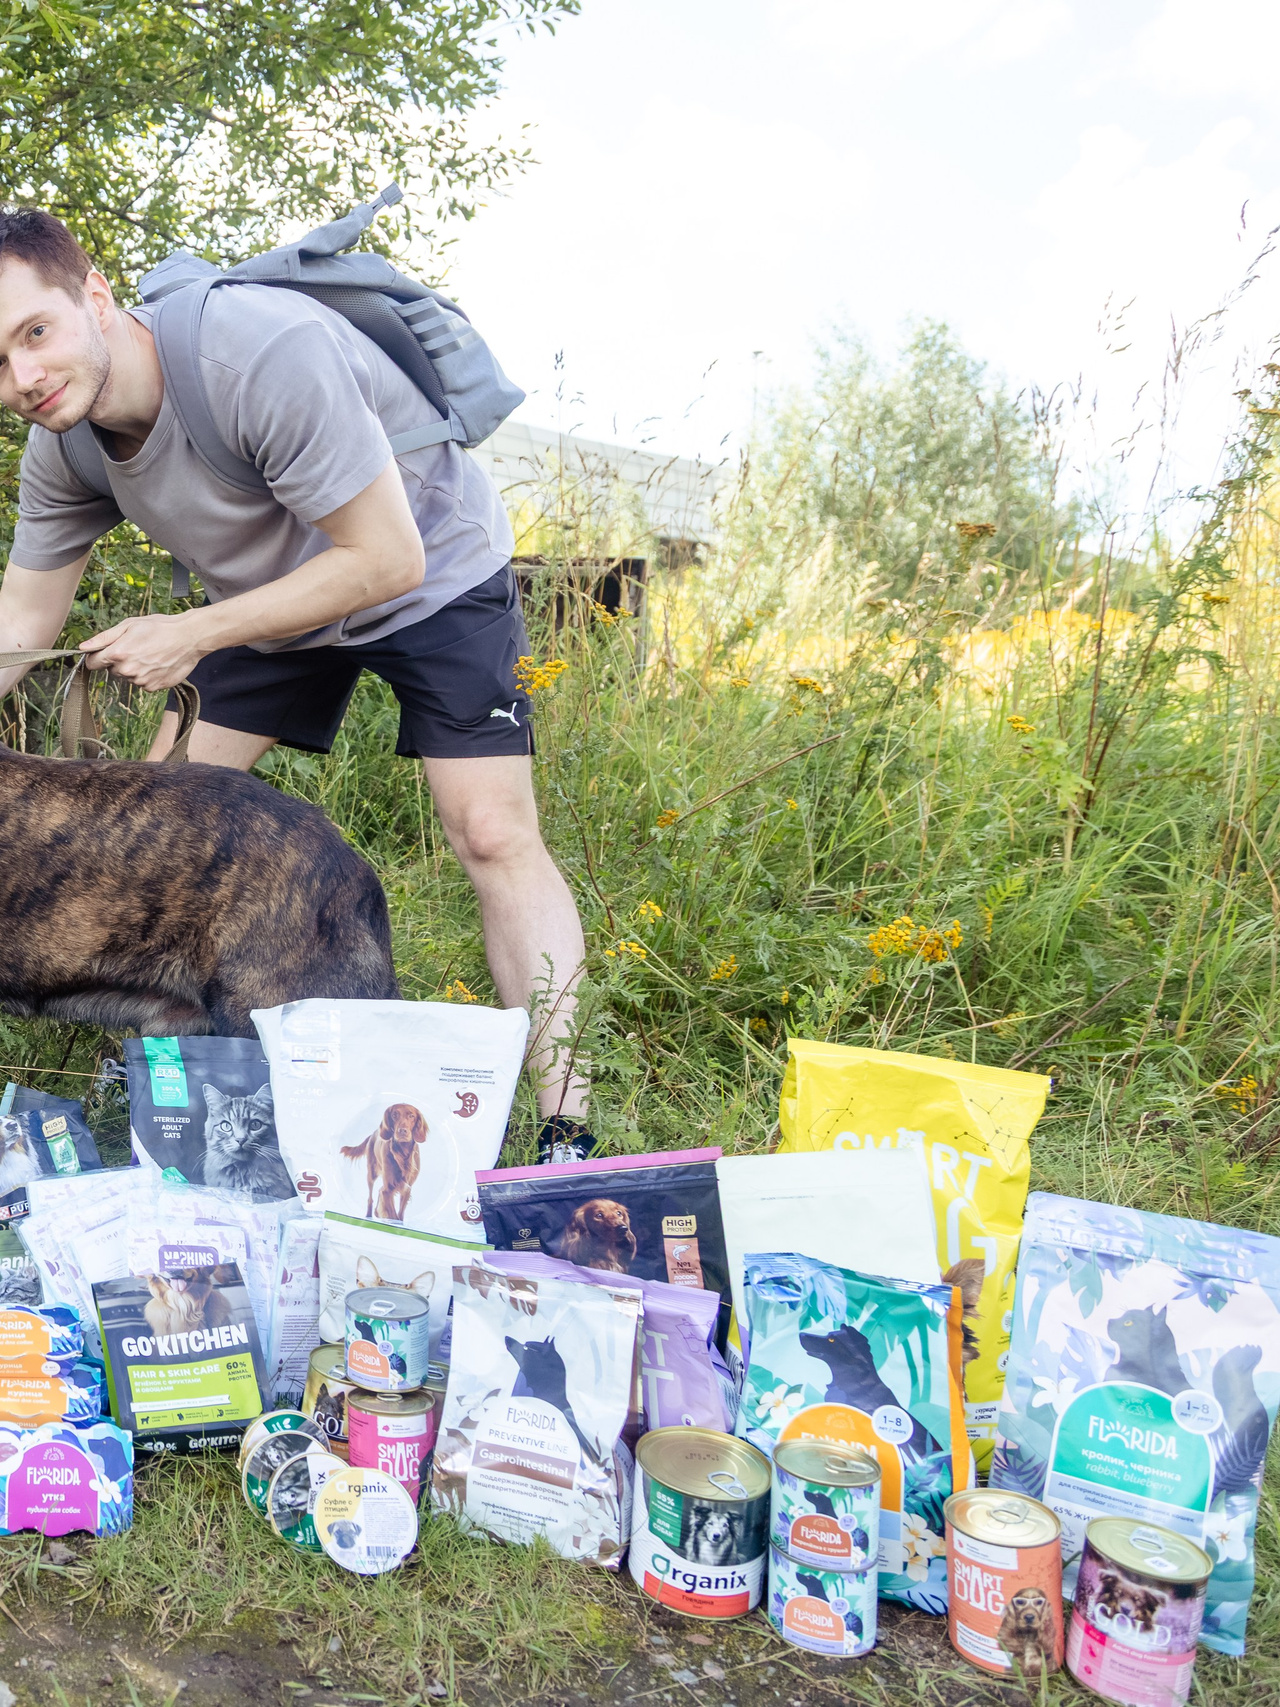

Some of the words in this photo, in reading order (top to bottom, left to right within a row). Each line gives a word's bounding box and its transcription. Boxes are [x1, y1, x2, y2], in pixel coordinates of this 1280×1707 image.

[153, 1116, 191, 1124] STERILIZED
[122, 1323, 249, 1358] GO'KITCHEN
[352, 1350, 381, 1366] FLORIDA
[132, 1370, 156, 1380] HAIR
[158, 1370, 166, 1378] &
[168, 1367, 192, 1378] SKIN
[194, 1364, 220, 1374] CARE
[227, 1368, 248, 1376] ANIMAL
[228, 1374, 252, 1382] PROTEIN
[0, 1380, 52, 1390] FLORIDA
[506, 1407, 556, 1432] FLORIDA
[488, 1428, 546, 1449] PREVENTIVE
[547, 1442, 568, 1454] LINE
[1088, 1415, 1180, 1460] FLORIDA
[378, 1442, 420, 1458] SMART
[378, 1456, 420, 1482] DOG
[479, 1448, 570, 1478] Gastrointestinal
[1082, 1448, 1128, 1469] кролик,
[1130, 1462, 1182, 1482] черника
[26, 1466, 82, 1486] FLORIDA
[480, 1474, 528, 1488] поддержание
[530, 1484, 563, 1497] здоровья
[1086, 1462, 1120, 1480] rabbit,
[1123, 1470, 1174, 1494] blueberry
[42, 1493, 66, 1504] утка
[335, 1480, 388, 1498] Organix
[472, 1480, 538, 1499] пищеварительной
[538, 1494, 570, 1507] системы
[62, 1506, 80, 1514] собак
[324, 1498, 346, 1506] Суфле
[482, 1501, 534, 1518] профилактическая
[1058, 1480, 1071, 1488] для
[1072, 1484, 1132, 1506] стерилизованных
[1172, 1513, 1194, 1524] кошек
[1084, 1495, 1106, 1506] indoor
[1052, 1506, 1073, 1517] 65%
[652, 1522, 674, 1538] СОБАК
[656, 1518, 671, 1530] ДЛЯ
[800, 1526, 842, 1545] FLORIDA
[652, 1554, 747, 1594] Organix
[954, 1558, 1004, 1591] SMART
[682, 1595, 714, 1606] Говядина
[954, 1573, 1005, 1616] DOG
[794, 1608, 834, 1628] FLORIDA
[1094, 1602, 1172, 1647] GOLD
